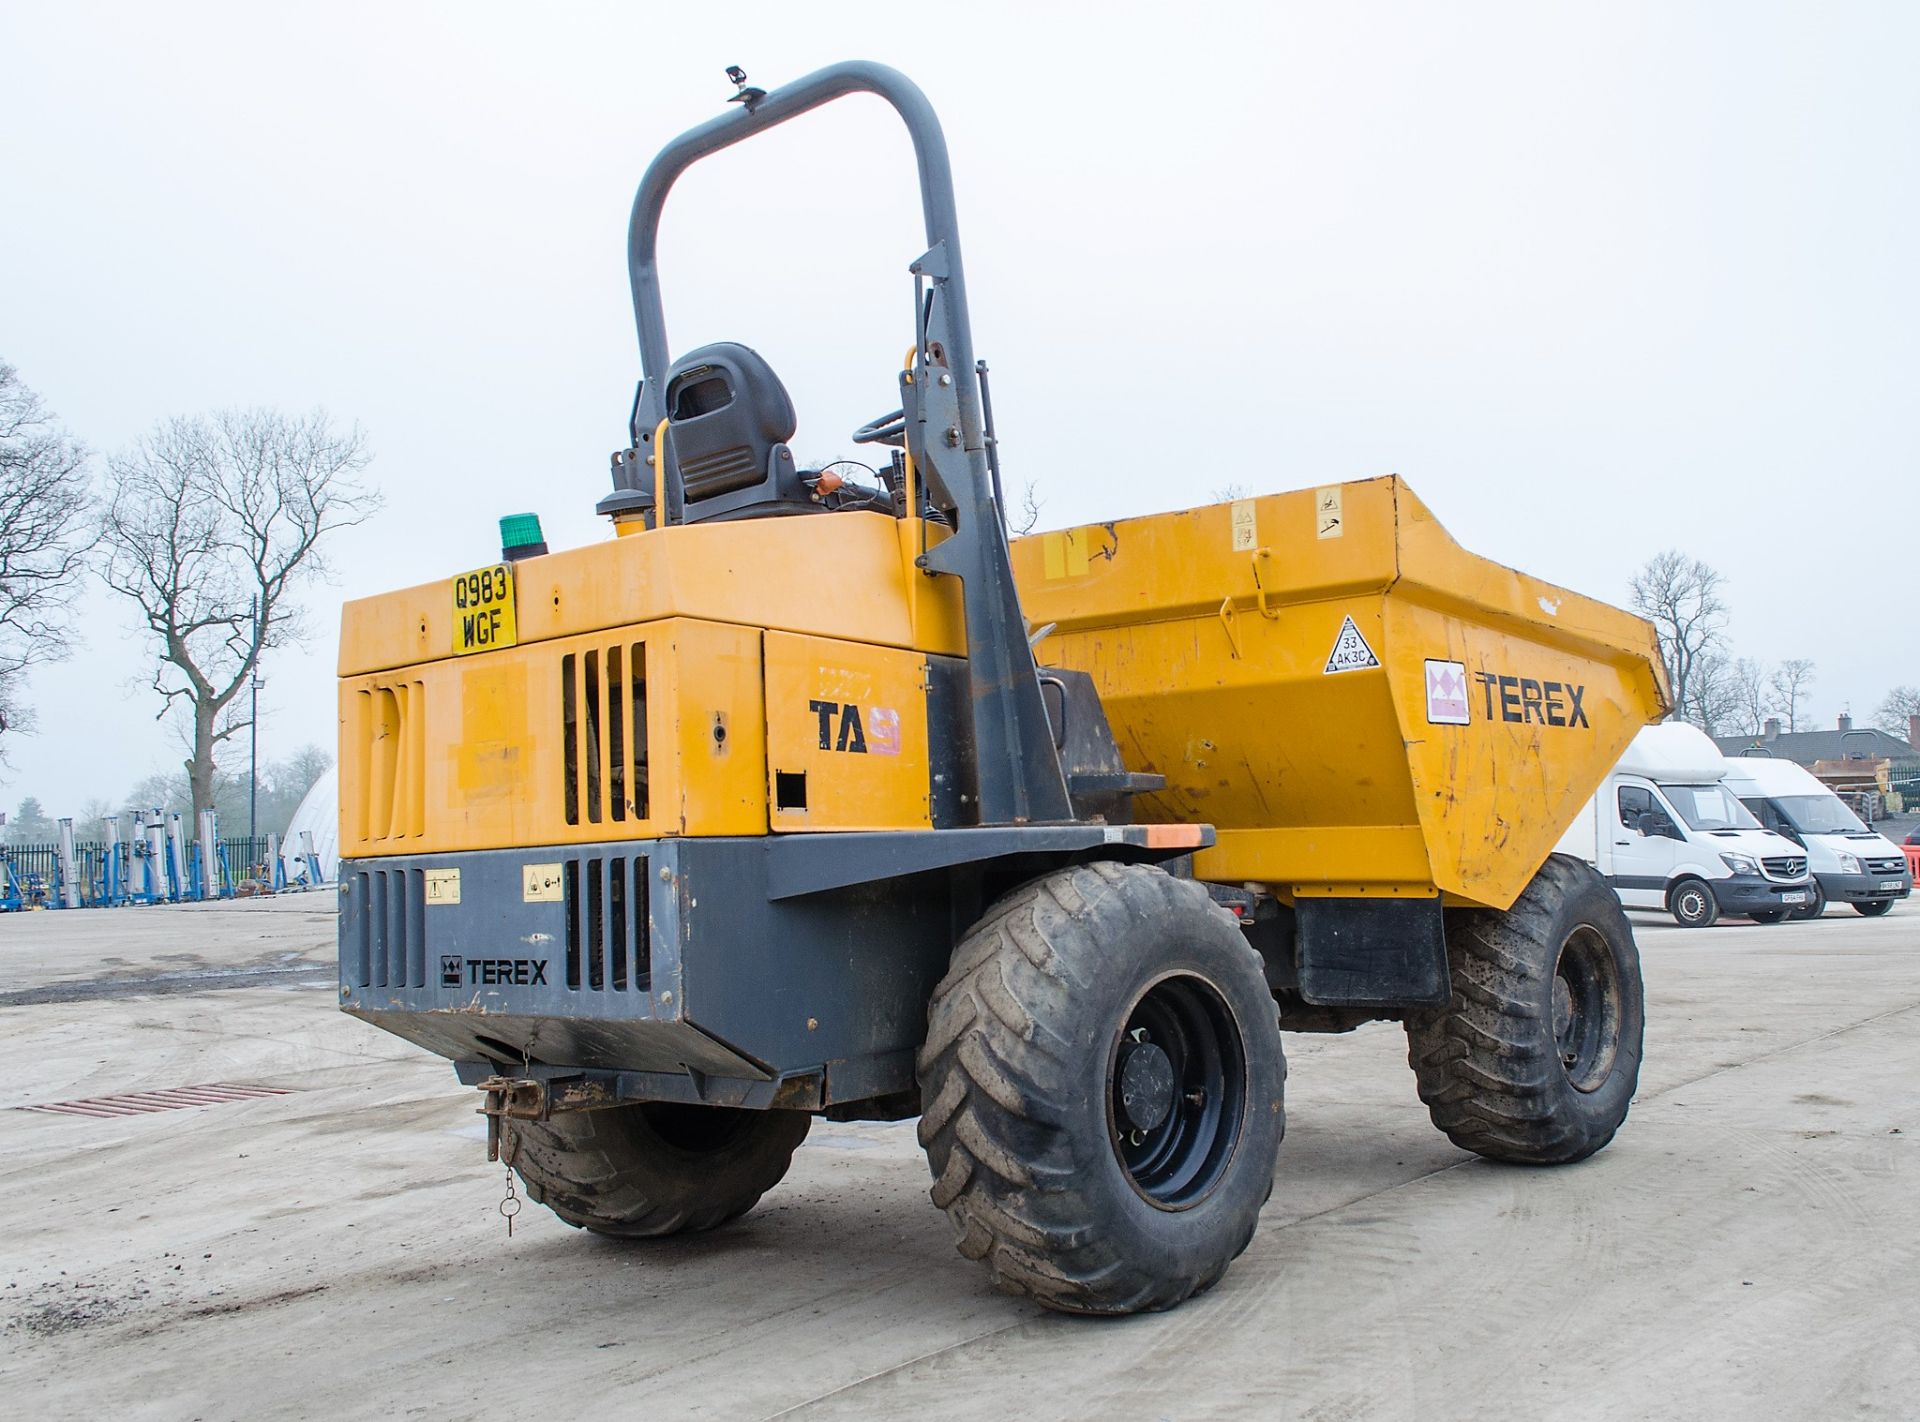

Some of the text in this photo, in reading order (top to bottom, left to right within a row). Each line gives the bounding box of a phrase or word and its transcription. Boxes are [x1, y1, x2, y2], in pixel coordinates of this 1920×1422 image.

[456, 567, 506, 608] Q983
[463, 609, 501, 648] WGF
[1343, 636, 1357, 649] 33
[1337, 650, 1366, 664] AK3C
[1475, 671, 1590, 729] TEREX
[466, 959, 548, 986] TEREX
